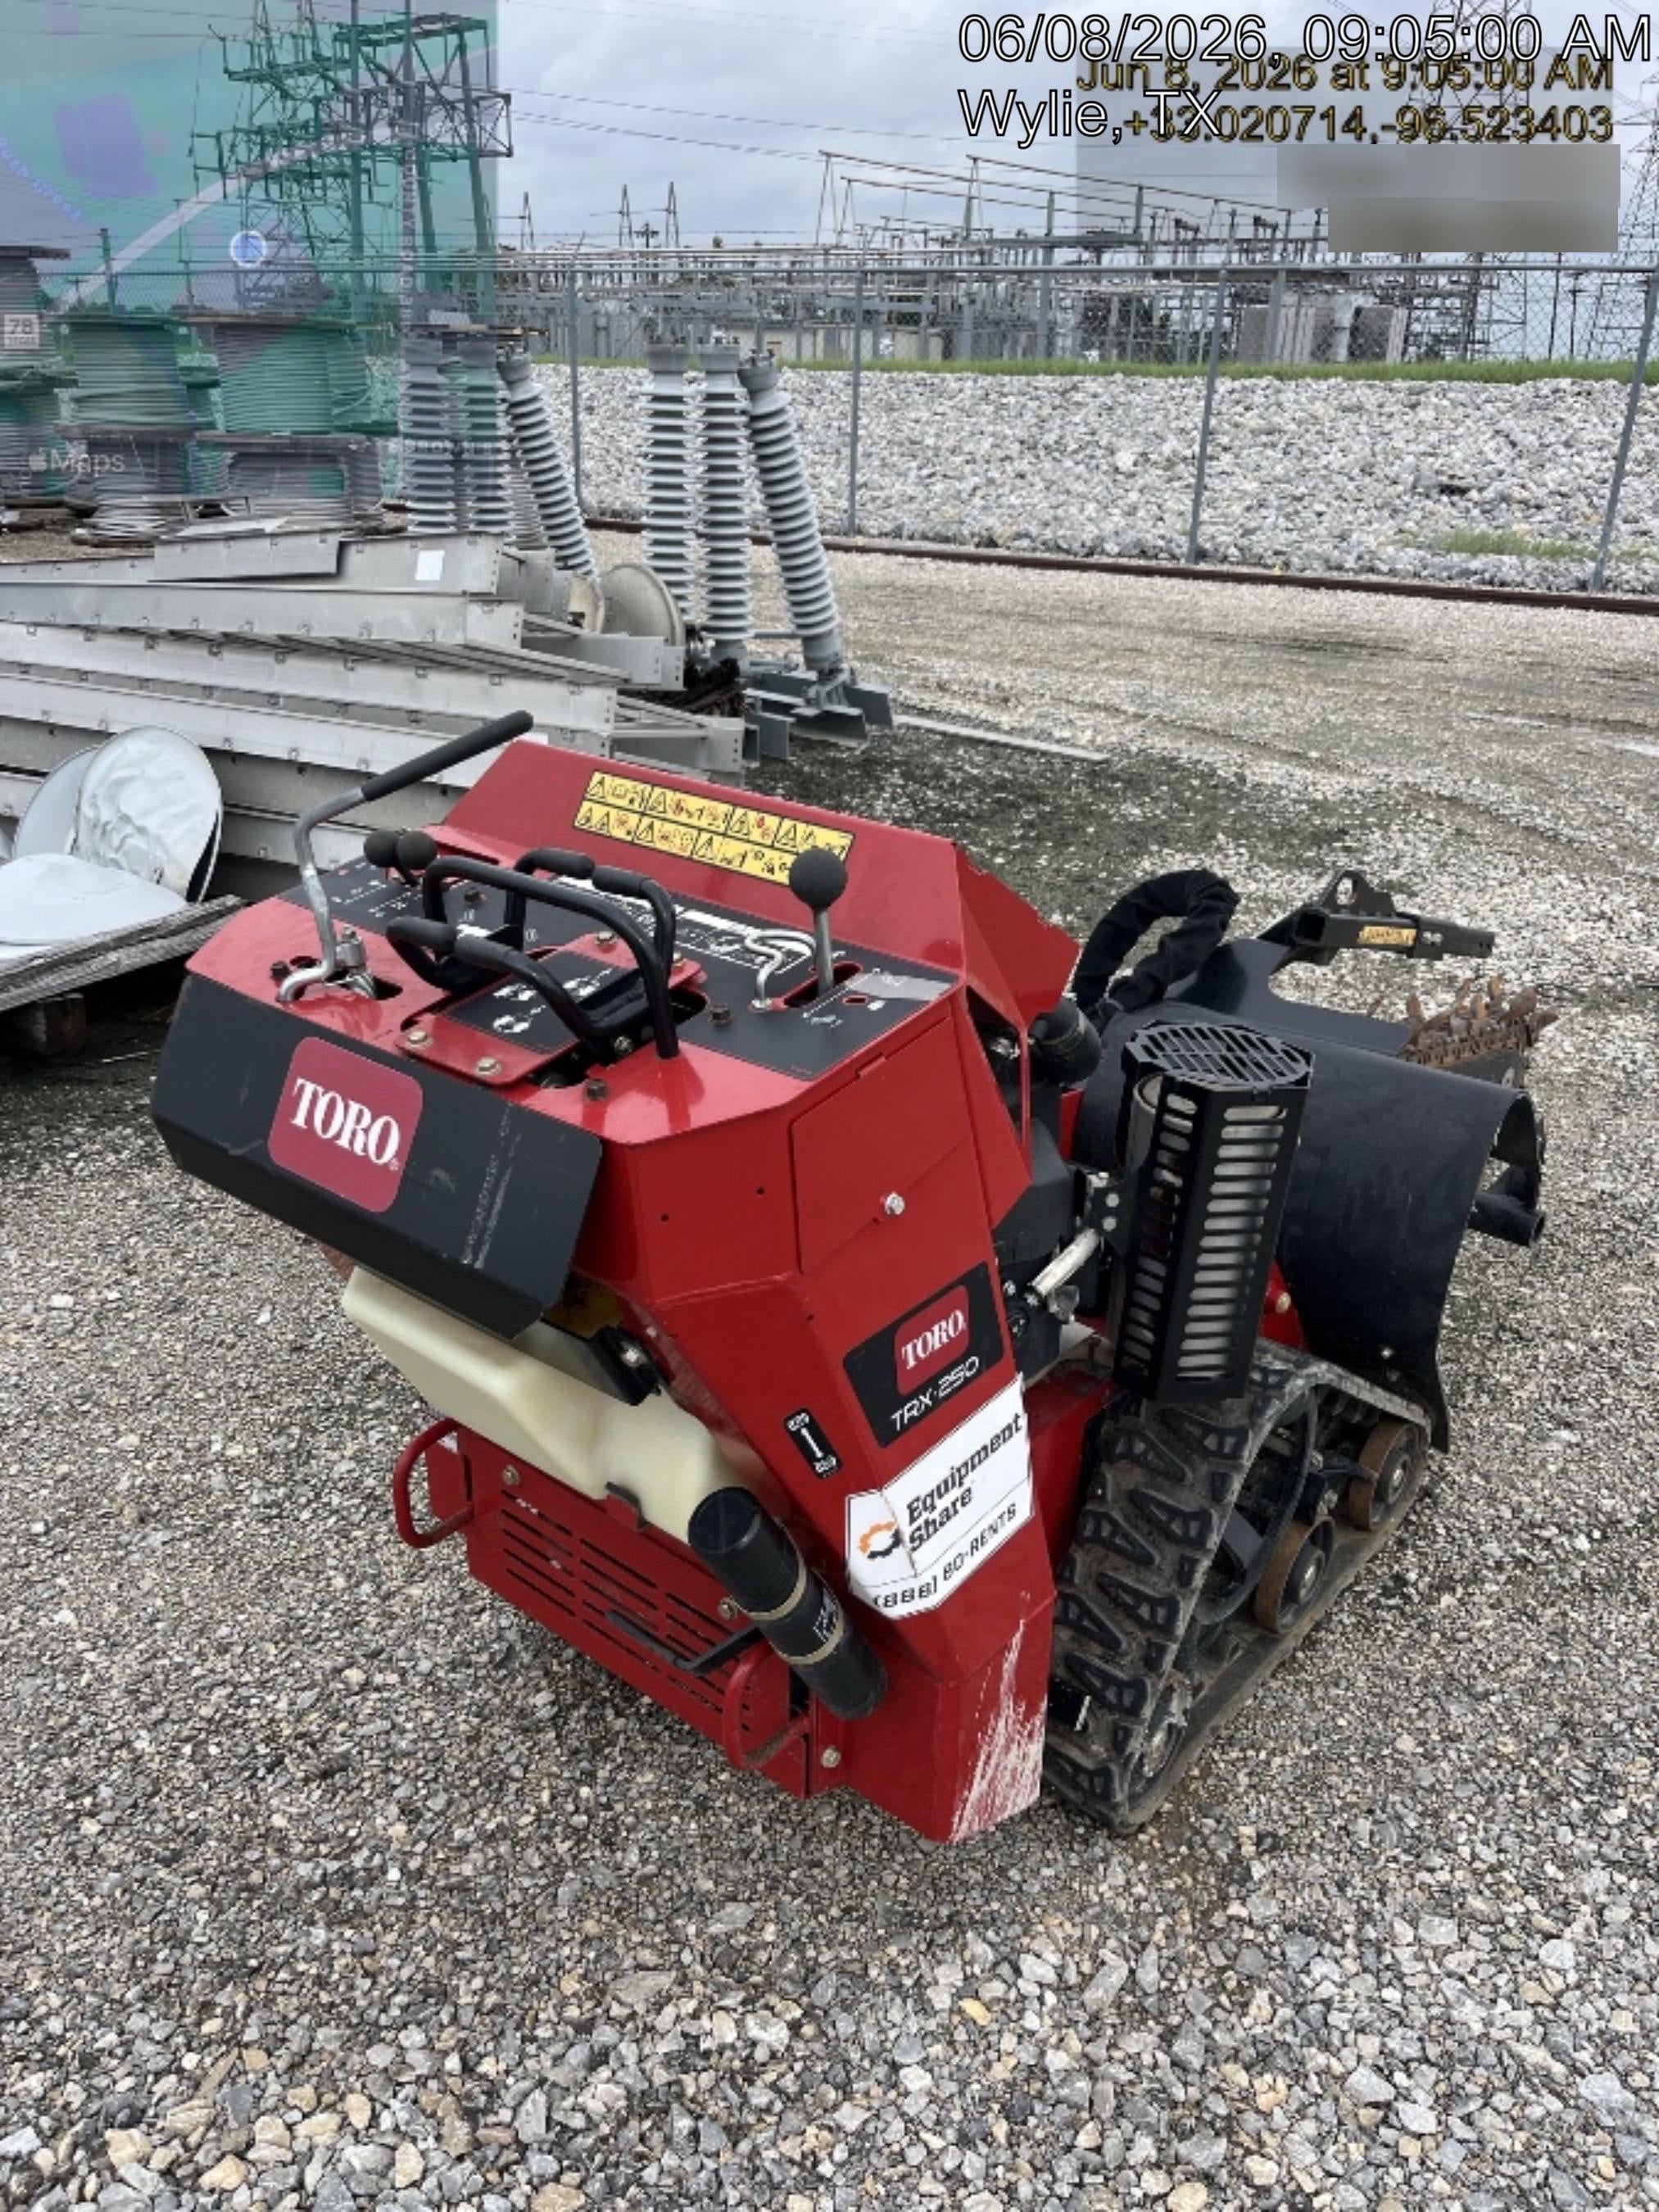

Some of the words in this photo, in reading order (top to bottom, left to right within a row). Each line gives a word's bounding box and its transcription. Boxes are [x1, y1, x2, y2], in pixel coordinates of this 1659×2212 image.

[290, 1077, 401, 1167] TORO
[901, 1308, 966, 1370] TORO
[905, 1411, 1024, 1527] Equipment
[908, 1485, 973, 1553] Share
